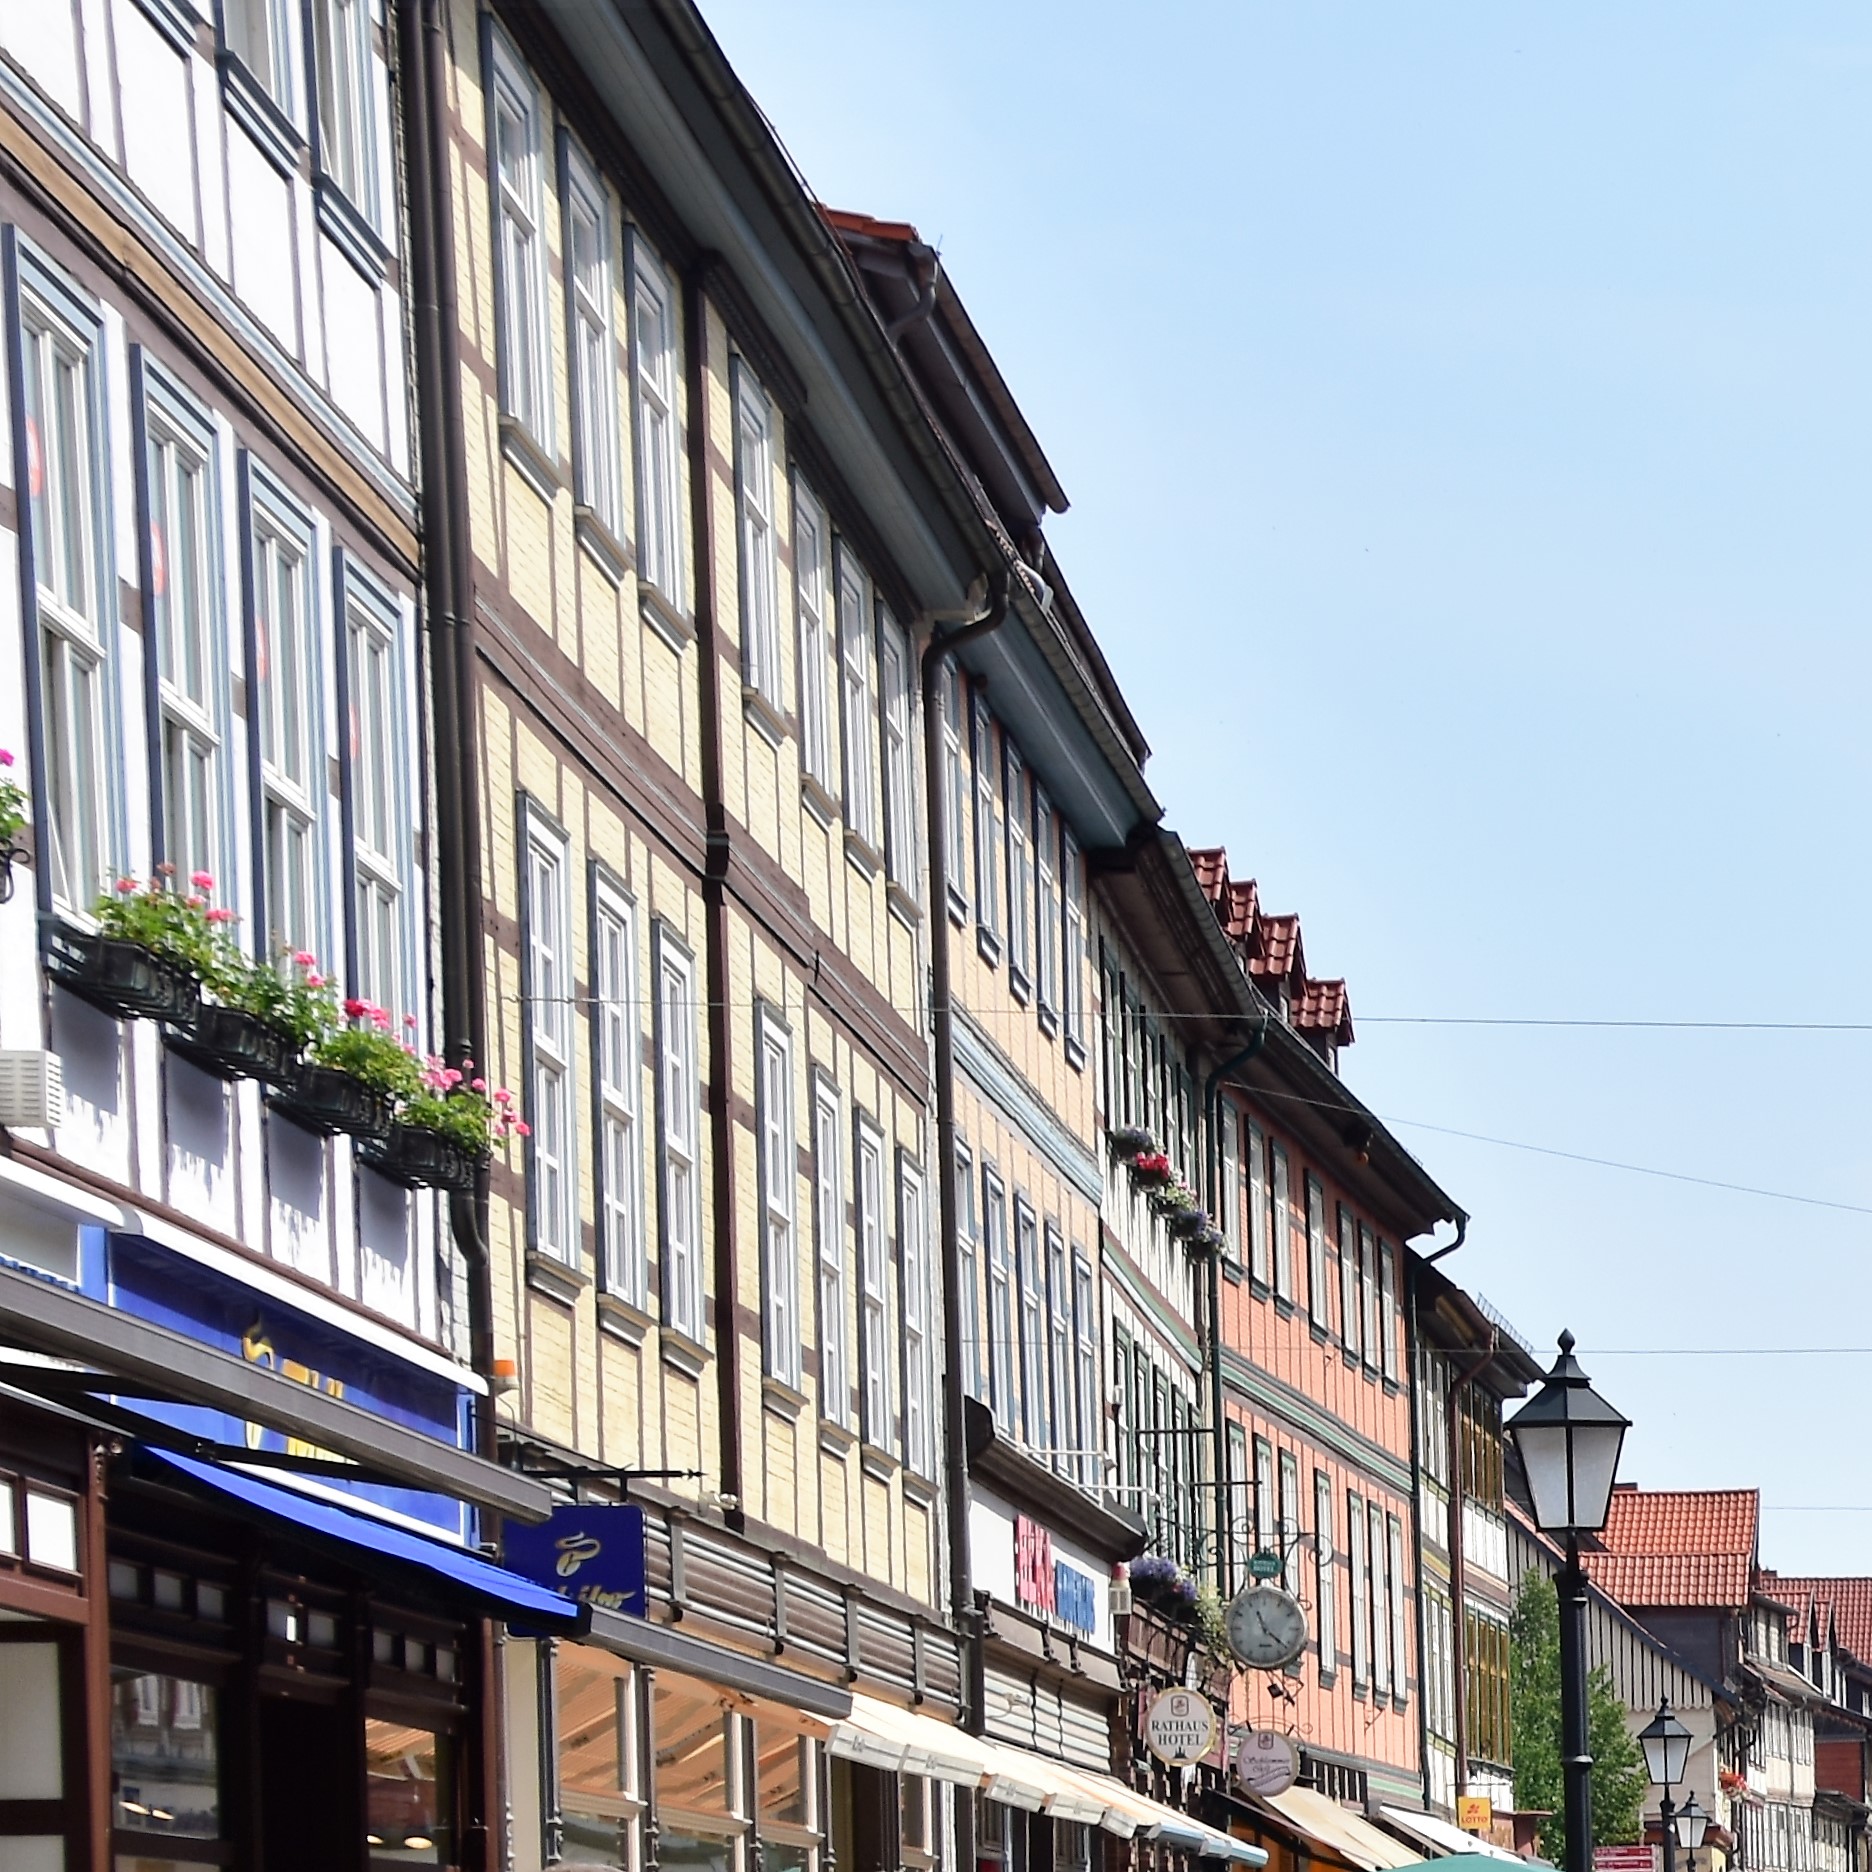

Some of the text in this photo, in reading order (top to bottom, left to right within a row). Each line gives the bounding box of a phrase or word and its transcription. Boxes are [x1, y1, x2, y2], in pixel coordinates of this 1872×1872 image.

[1151, 1718, 1210, 1733] RATHAUS
[1157, 1733, 1204, 1746] HOTEL
[1461, 1816, 1488, 1824] LOTTO
